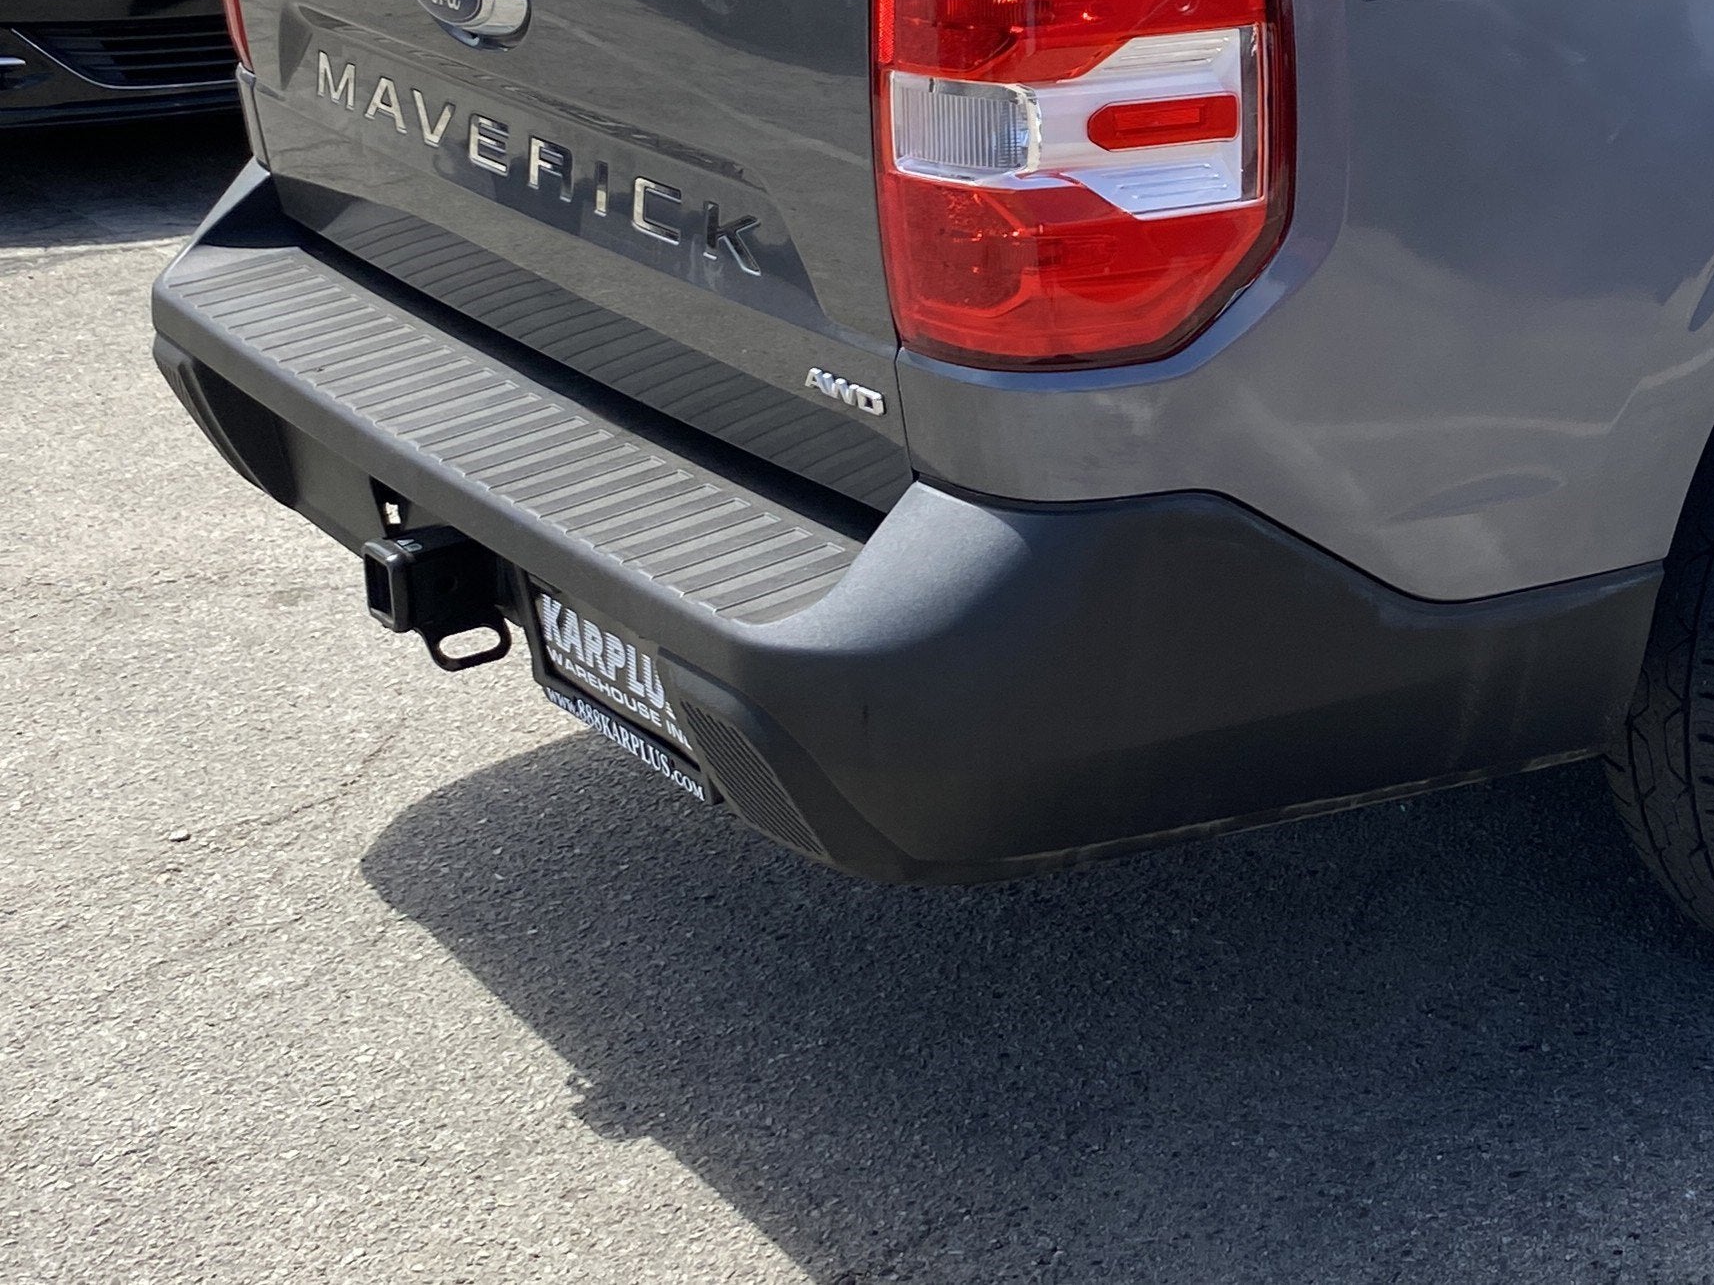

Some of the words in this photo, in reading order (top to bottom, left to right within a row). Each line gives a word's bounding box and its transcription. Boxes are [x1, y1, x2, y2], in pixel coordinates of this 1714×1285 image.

[316, 50, 762, 277] MAVERICK
[805, 367, 885, 417] AWD
[541, 593, 676, 720] KARPLU
[546, 645, 662, 727] WAREHOUSE
